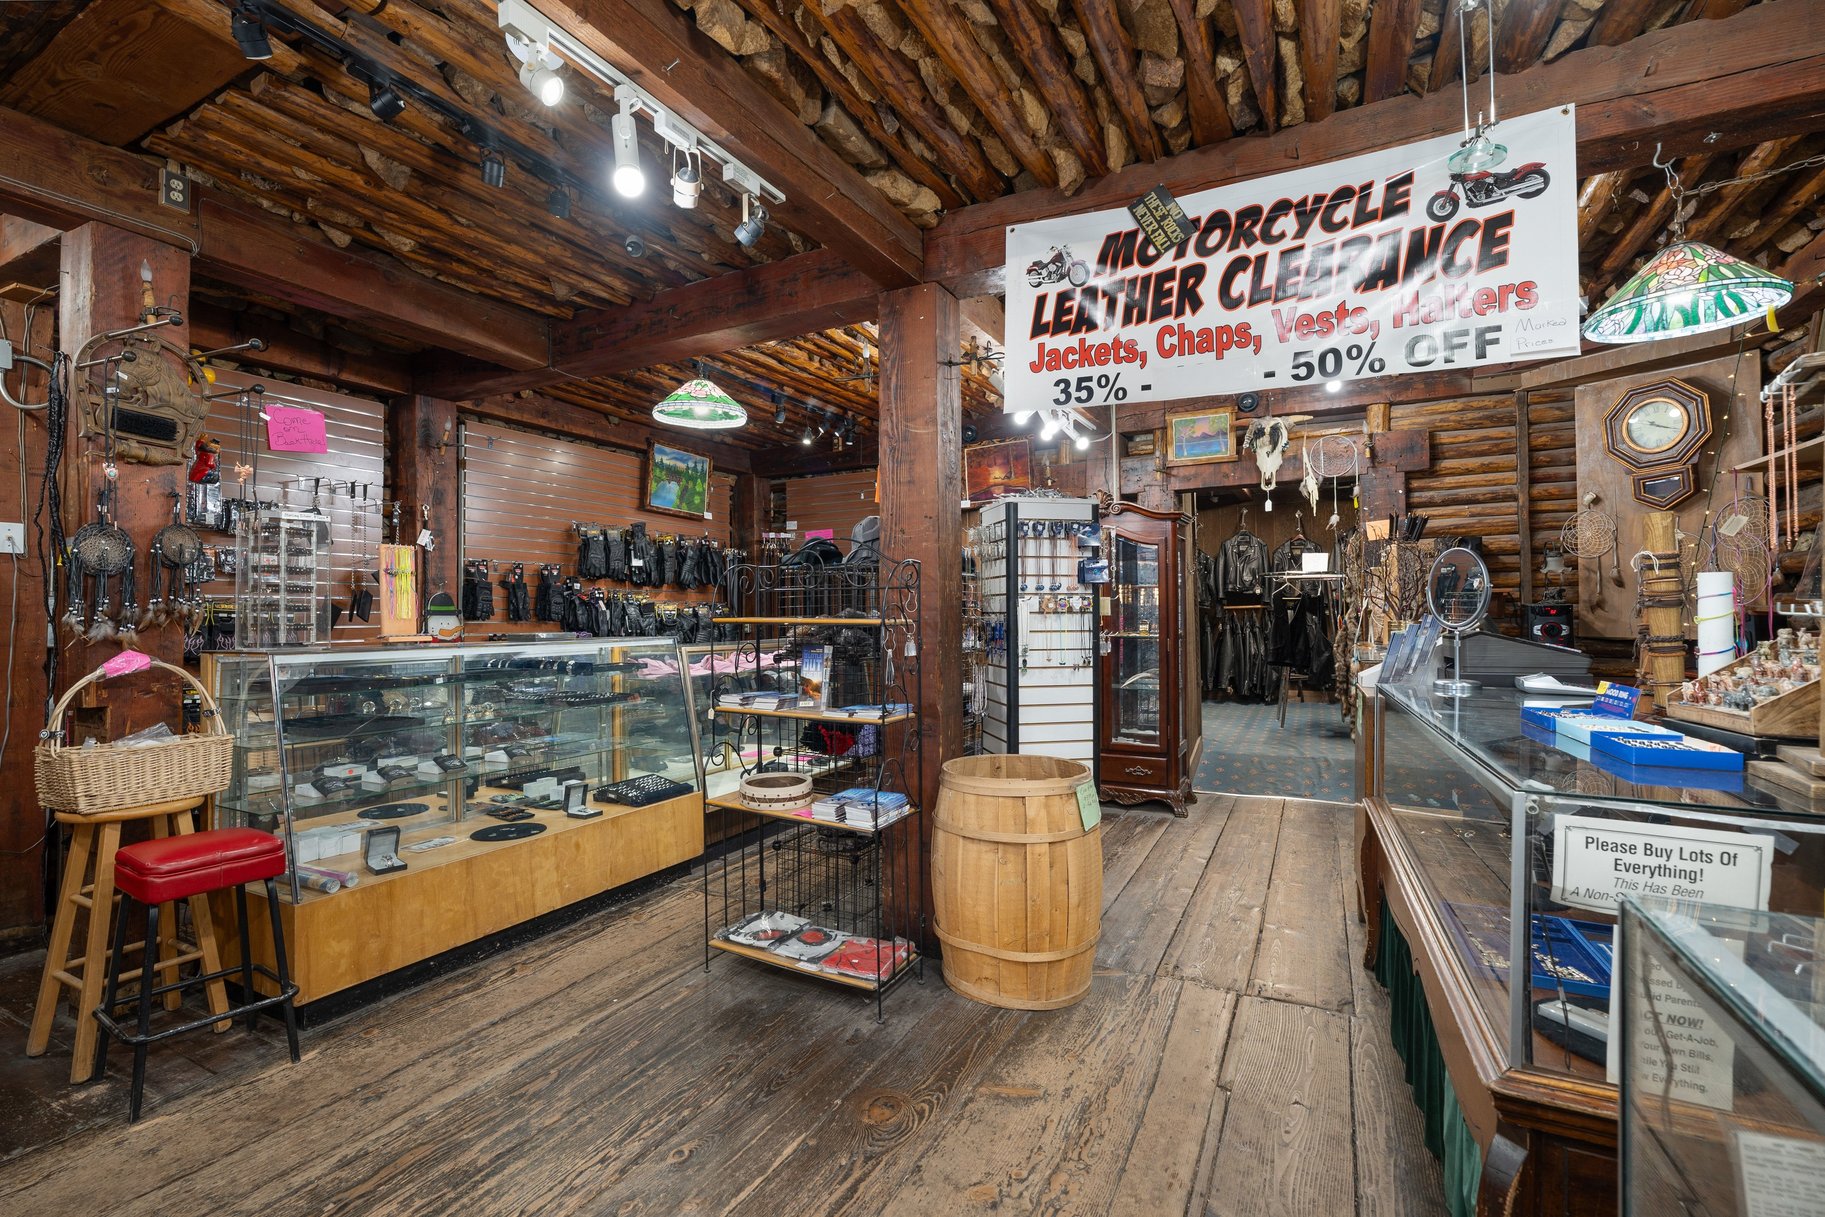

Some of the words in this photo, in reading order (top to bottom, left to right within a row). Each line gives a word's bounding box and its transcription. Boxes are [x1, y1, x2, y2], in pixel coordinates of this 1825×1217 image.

[1144, 191, 1168, 220] THESE
[1161, 215, 1185, 243] ROCKS
[1165, 202, 1183, 220] NO
[1133, 203, 1159, 235] NEVER
[1150, 228, 1171, 253] FALL
[1029, 261, 1207, 341] LEATHER
[1218, 209, 1515, 312] CLEARANCE
[1029, 333, 1147, 374] Jackets,
[1156, 320, 1263, 361] Chaps,
[1271, 300, 1381, 344] Vests,
[1392, 281, 1540, 329] Halters
[1291, 341, 1386, 382] 50%
[1404, 324, 1503, 368] OFF
[1052, 372, 1128, 406] 35%
[273, 408, 312, 426] Come
[1585, 836, 1637, 855] Please
[1644, 842, 1673, 862] Buy
[1679, 847, 1713, 864] Lots
[1720, 851, 1738, 867] Of
[1614, 858, 1704, 884] Everything!
[1570, 886, 1580, 897] A
[1613, 877, 1639, 891] This
[1643, 881, 1668, 895] Has
[1672, 884, 1704, 899] Been
[1667, 1014, 1705, 1029] NOW!
[1666, 1030, 1719, 1048] Get-A-Job,
[1689, 1049, 1714, 1062] Bills,
[1680, 1063, 1700, 1075] Still
